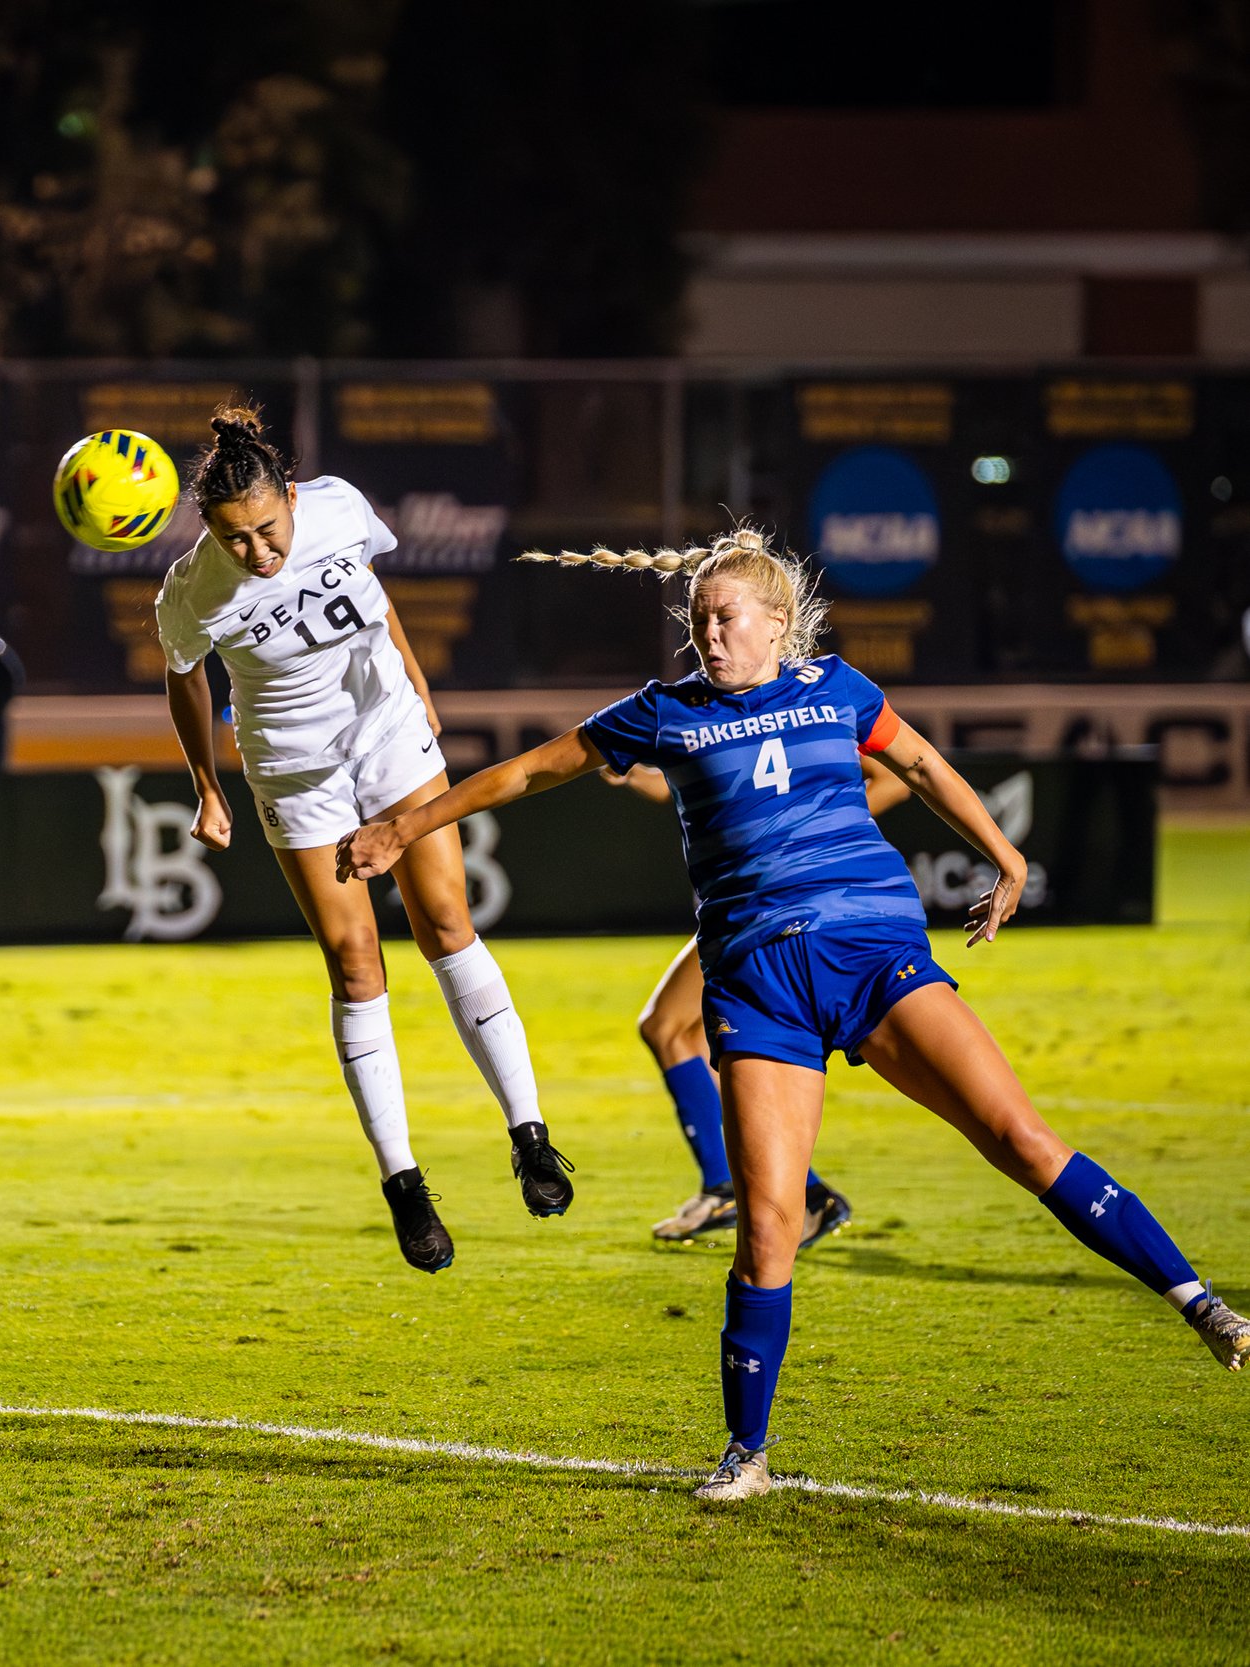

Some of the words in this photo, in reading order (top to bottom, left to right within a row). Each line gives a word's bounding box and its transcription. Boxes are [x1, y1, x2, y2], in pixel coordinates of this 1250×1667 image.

[250, 558, 357, 645] BEACH
[293, 594, 367, 648] 19
[680, 705, 839, 753] BAKERSFIELD
[752, 737, 793, 796] 4
